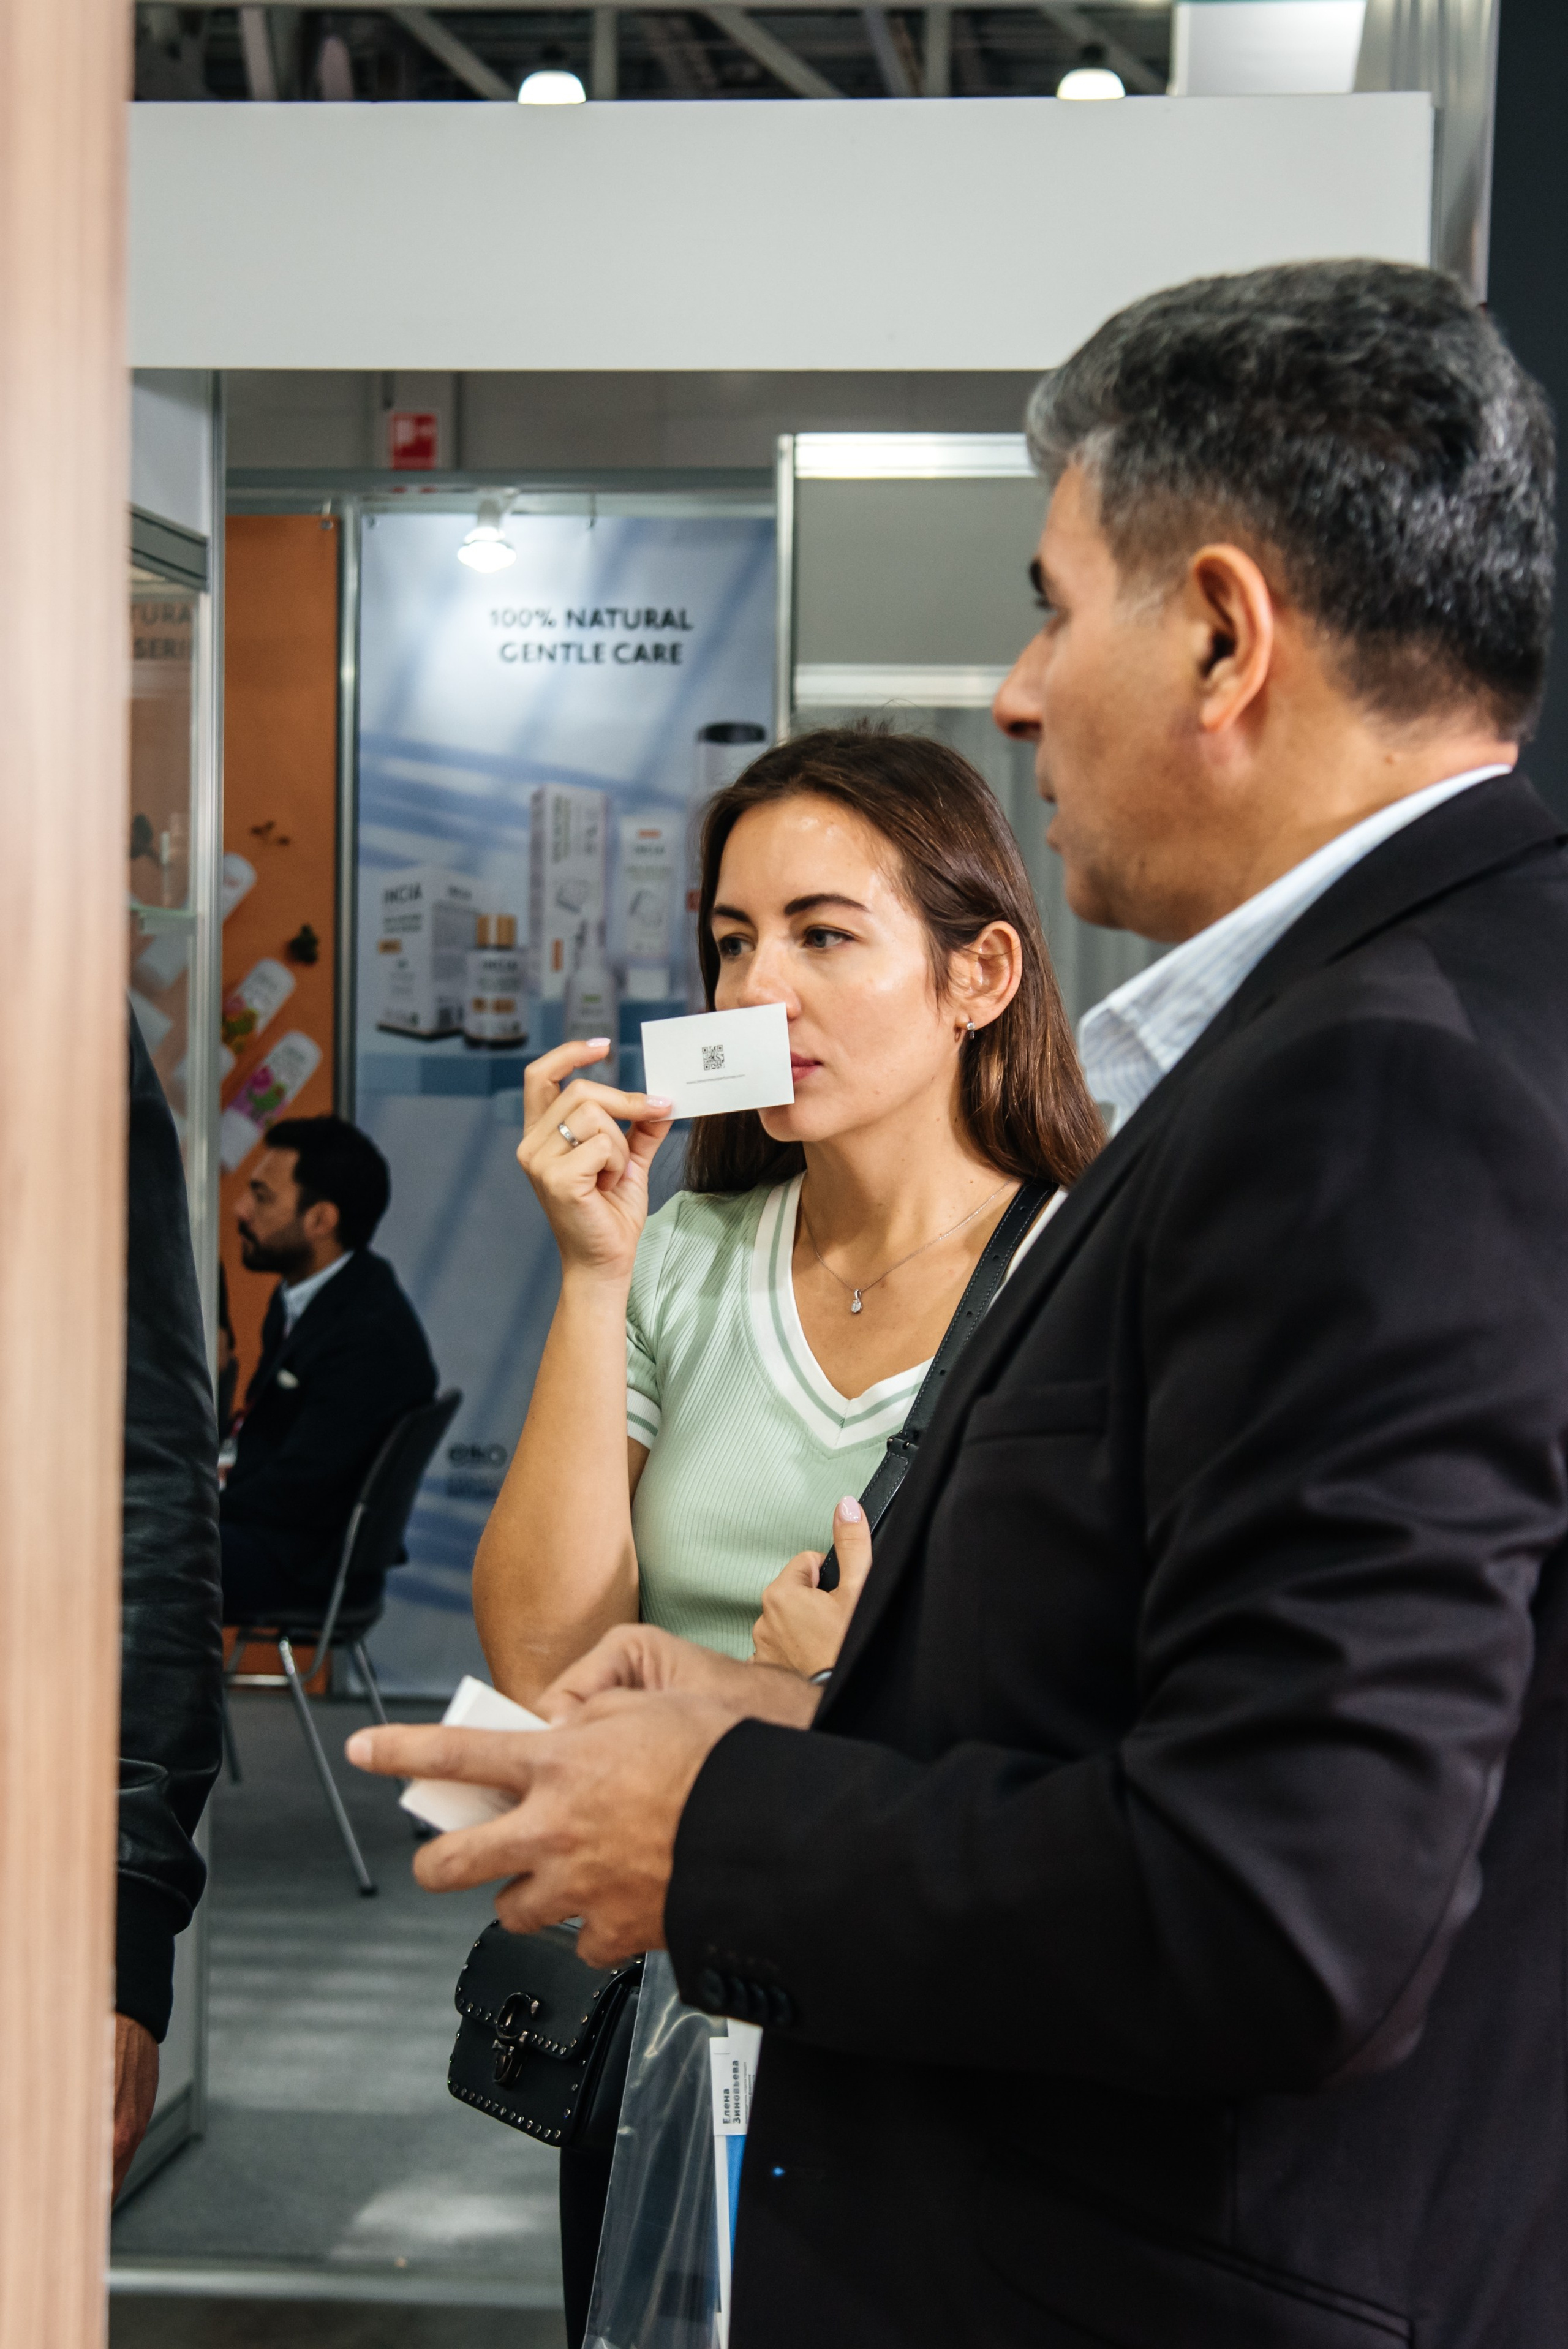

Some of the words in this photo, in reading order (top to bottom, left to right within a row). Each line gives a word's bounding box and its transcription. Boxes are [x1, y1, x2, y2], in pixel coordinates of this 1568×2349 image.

[489, 608, 556, 628] 100%
[567, 608, 693, 630] NATURAL
[499, 641, 605, 664] GENTLE
[613, 641, 684, 665] CARE
